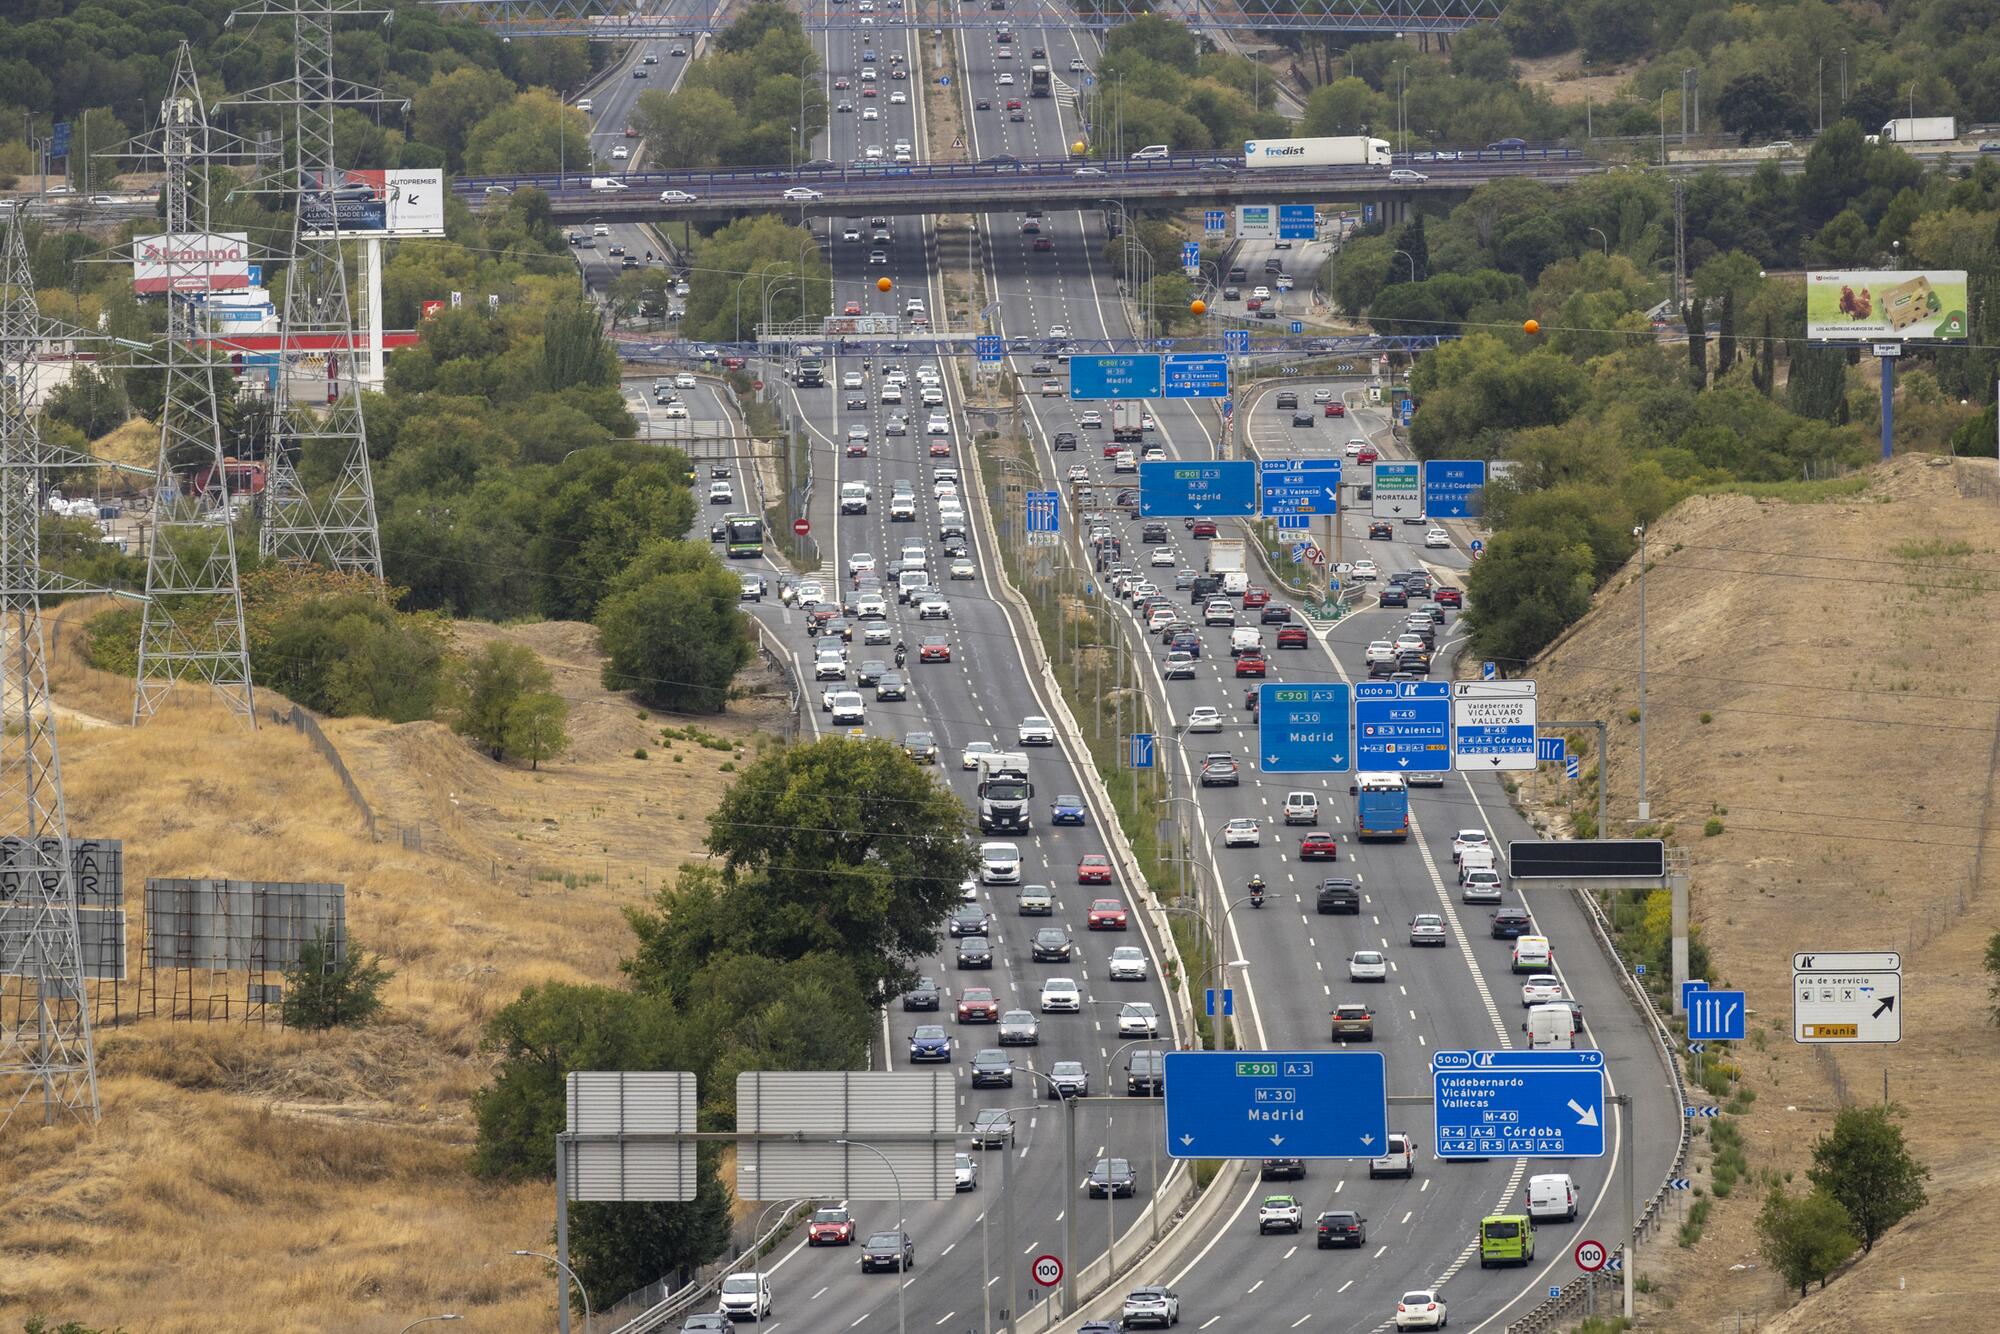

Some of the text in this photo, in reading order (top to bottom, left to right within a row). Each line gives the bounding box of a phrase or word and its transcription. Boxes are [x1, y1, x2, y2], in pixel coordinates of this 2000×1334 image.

[1265, 146, 1305, 156] fredist
[1276, 692, 1333, 700] E-901 A-3
[1290, 714, 1319, 722] M-30
[1397, 726, 1441, 734] Valencia
[1290, 733, 1334, 742] Madrid
[1238, 1064, 1310, 1074] E-901 A-3
[1442, 1078, 1524, 1086] Valdebernardo
[1257, 1091, 1293, 1100] M-30
[1442, 1088, 1495, 1097] Vicálvaro
[1442, 1099, 1489, 1107] Vallecas
[1248, 1109, 1304, 1121] Madrid
[1485, 1113, 1516, 1121] M-40
[1442, 1126, 1562, 1136] R-4 A-4 Córdoba
[1443, 1141, 1562, 1149] A-42 R-5 A-5 A-6
[1580, 1250, 1600, 1261] 100
[1038, 1265, 1058, 1276] 100
